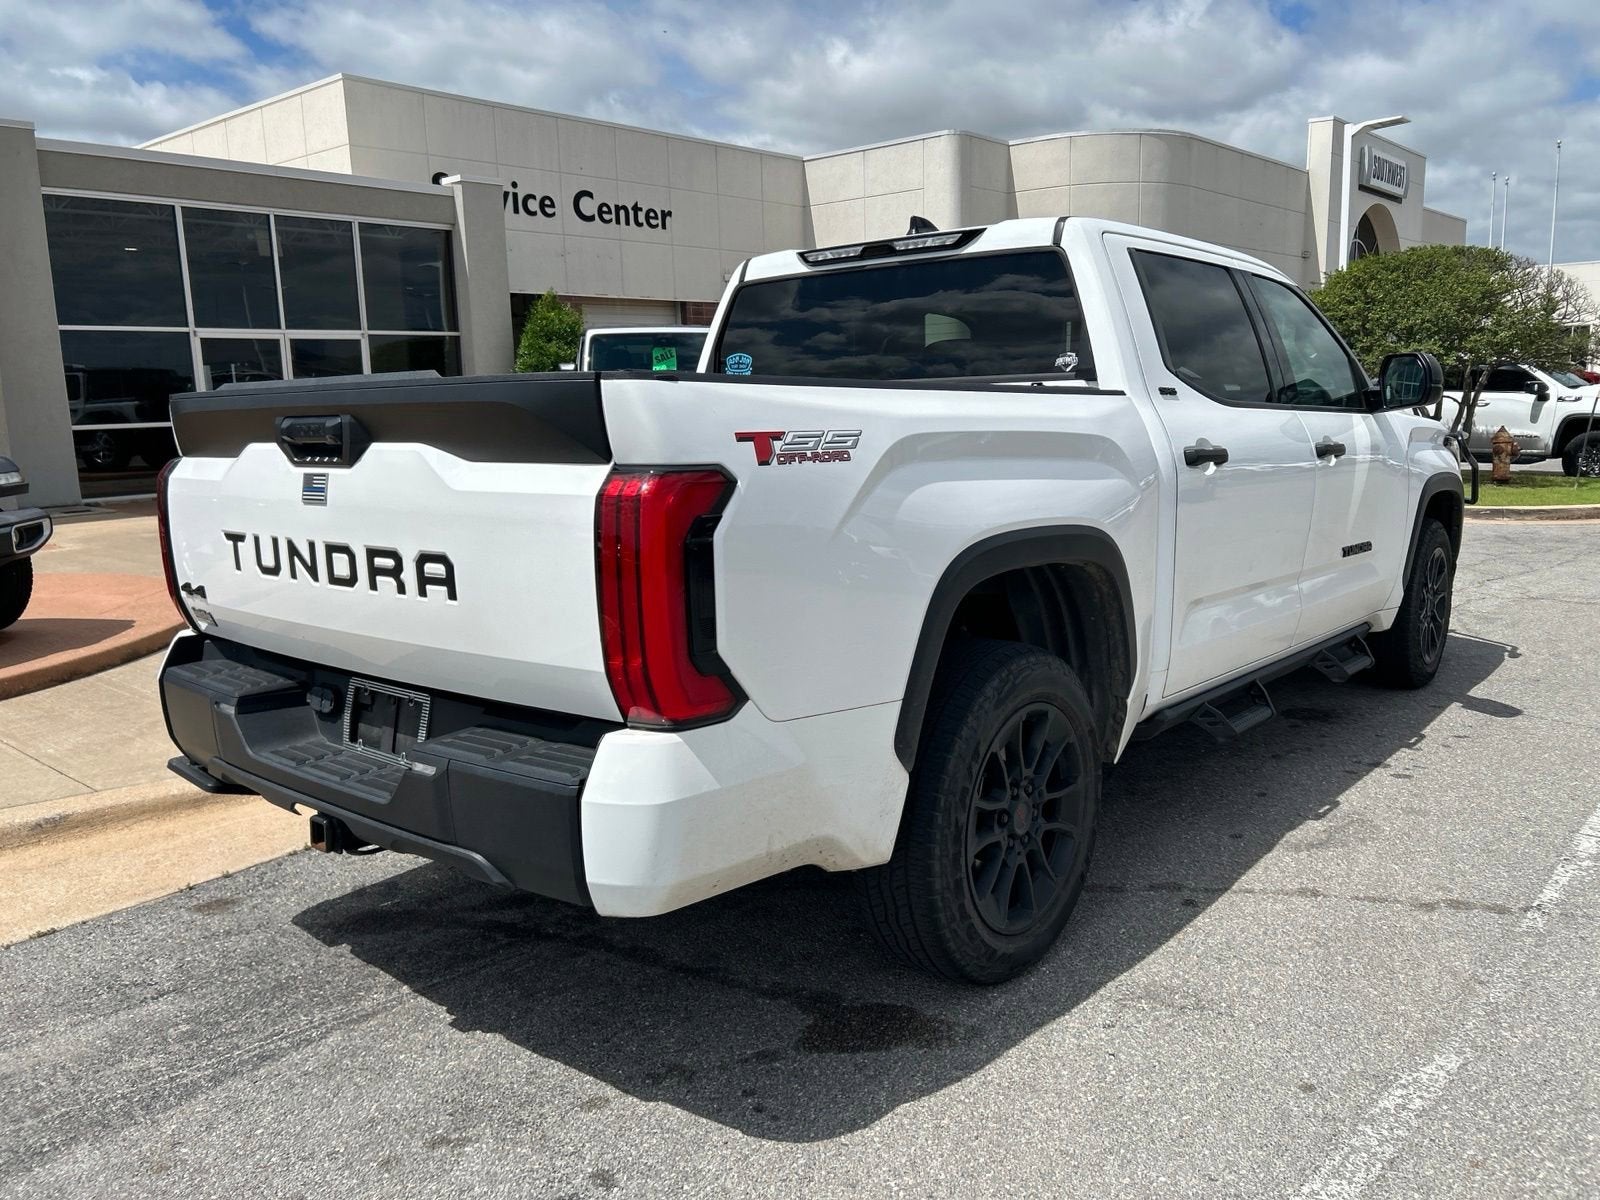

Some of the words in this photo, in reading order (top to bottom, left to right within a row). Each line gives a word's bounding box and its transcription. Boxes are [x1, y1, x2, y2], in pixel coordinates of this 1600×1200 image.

[1372, 154, 1406, 189] SOUTHWEST
[572, 189, 672, 230] Center
[654, 349, 675, 363] SALE
[776, 450, 852, 465] OFF-ROAD
[1341, 541, 1372, 558] TUNDRA
[221, 529, 458, 604] TUNDRA
